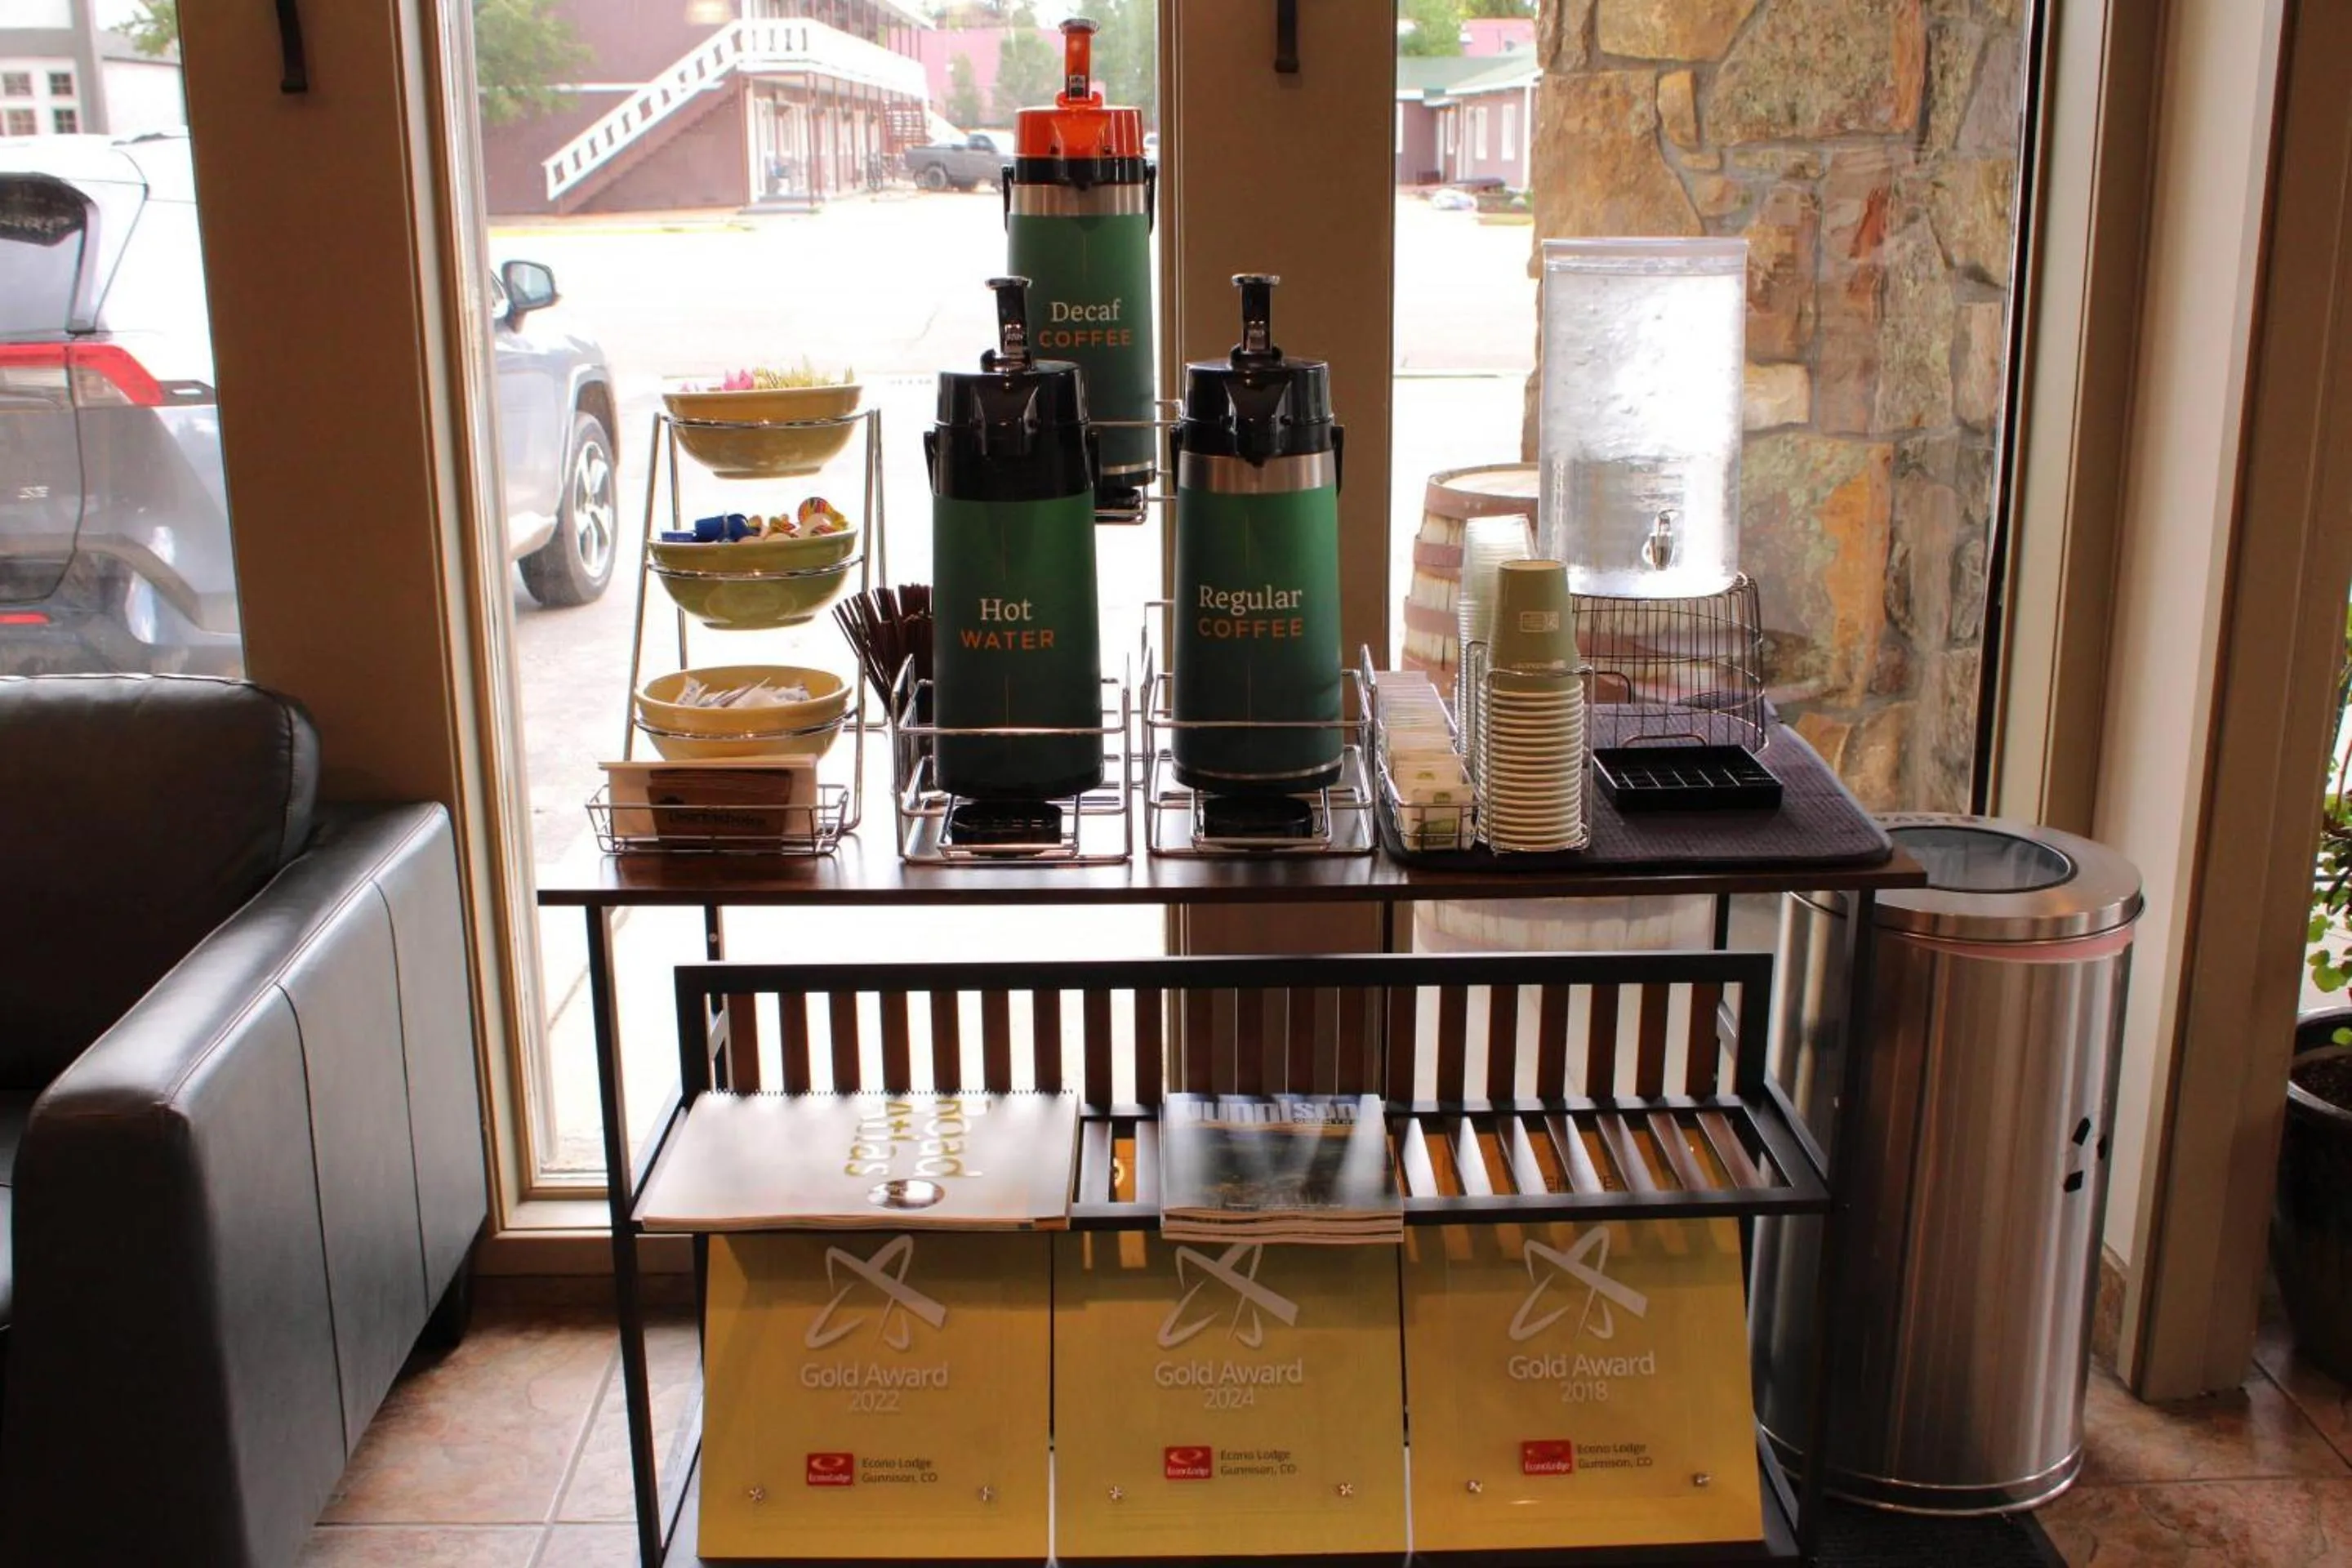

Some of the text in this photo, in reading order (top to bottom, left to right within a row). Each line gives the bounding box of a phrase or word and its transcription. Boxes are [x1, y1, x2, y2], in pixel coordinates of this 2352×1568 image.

[1051, 298, 1122, 323] Decaf
[1038, 329, 1133, 348] COFFEE
[979, 597, 1033, 621] Hot
[1198, 585, 1304, 616] Regular
[960, 629, 1055, 650] WATER
[1197, 618, 1304, 639] COFFEE
[1176, 1101, 1359, 1124] unnison
[800, 1361, 950, 1388] Gold Award
[1154, 1357, 1303, 1387] Gold Award
[1508, 1350, 1655, 1380] Gold Award
[849, 1390, 901, 1413] 2022
[1203, 1387, 1255, 1409] 2024
[1560, 1381, 1609, 1403] 2018
[1576, 1443, 1646, 1456] Econo Lodge
[862, 1457, 933, 1471] Econo Lodge
[1280, 1464, 1297, 1475] CO
[1637, 1455, 1653, 1468] CO
[920, 1472, 938, 1483] CO
